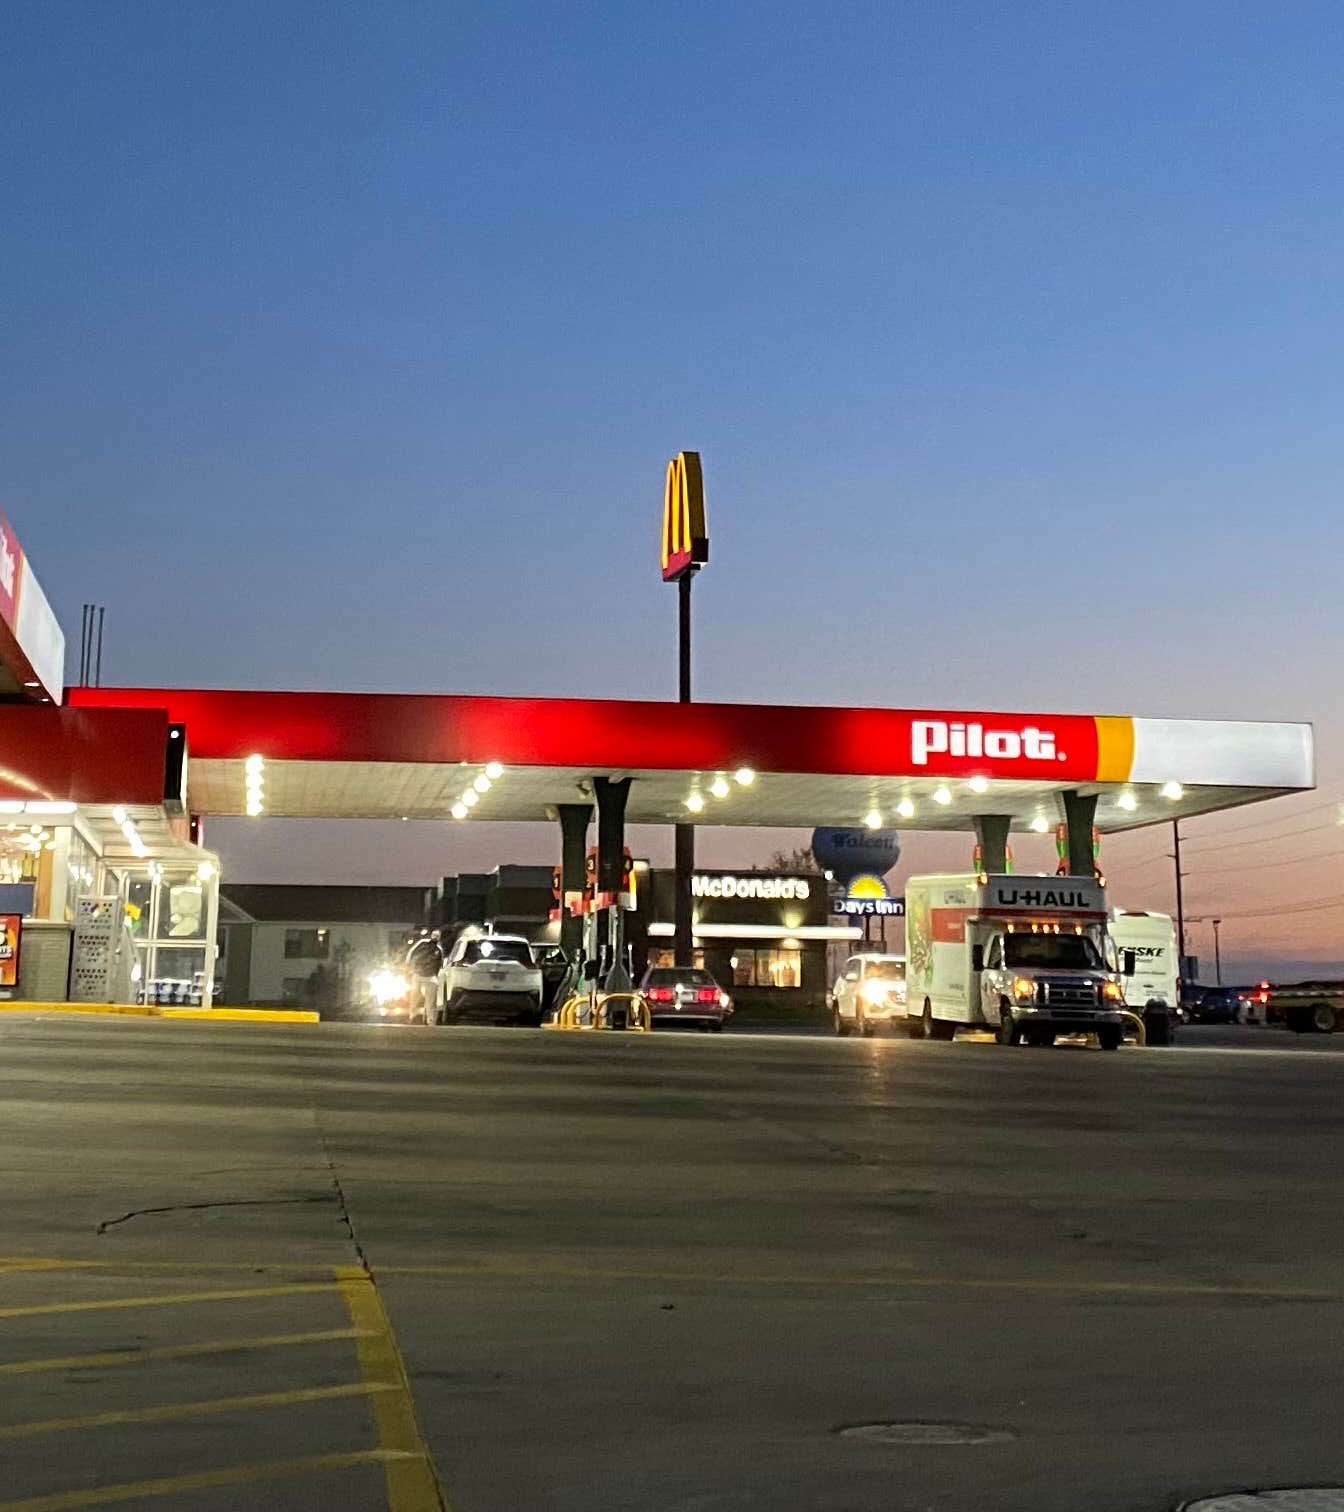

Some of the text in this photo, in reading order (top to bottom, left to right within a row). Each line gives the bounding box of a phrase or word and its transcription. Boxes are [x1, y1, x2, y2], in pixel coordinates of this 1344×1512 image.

[691, 876, 810, 899] McDonald's
[833, 899, 904, 915] Days Inn
[998, 889, 1090, 908] U-HAUL
